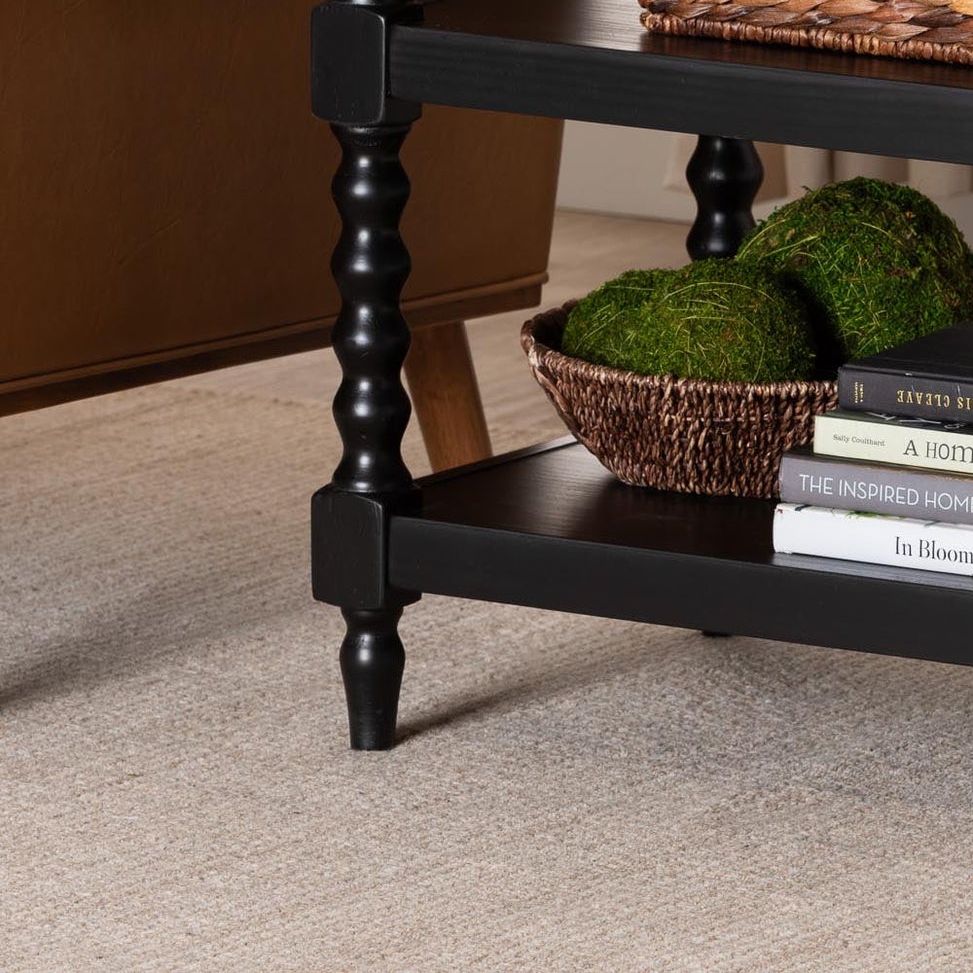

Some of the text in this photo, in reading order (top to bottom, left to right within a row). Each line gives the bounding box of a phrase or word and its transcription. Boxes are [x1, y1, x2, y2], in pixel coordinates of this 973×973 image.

[897, 390, 950, 408] CLEAVE
[833, 434, 849, 443] Sally
[903, 439, 919, 457] A
[800, 474, 833, 495] THE
[838, 479, 919, 506] INSPIRED
[895, 536, 913, 556] In
